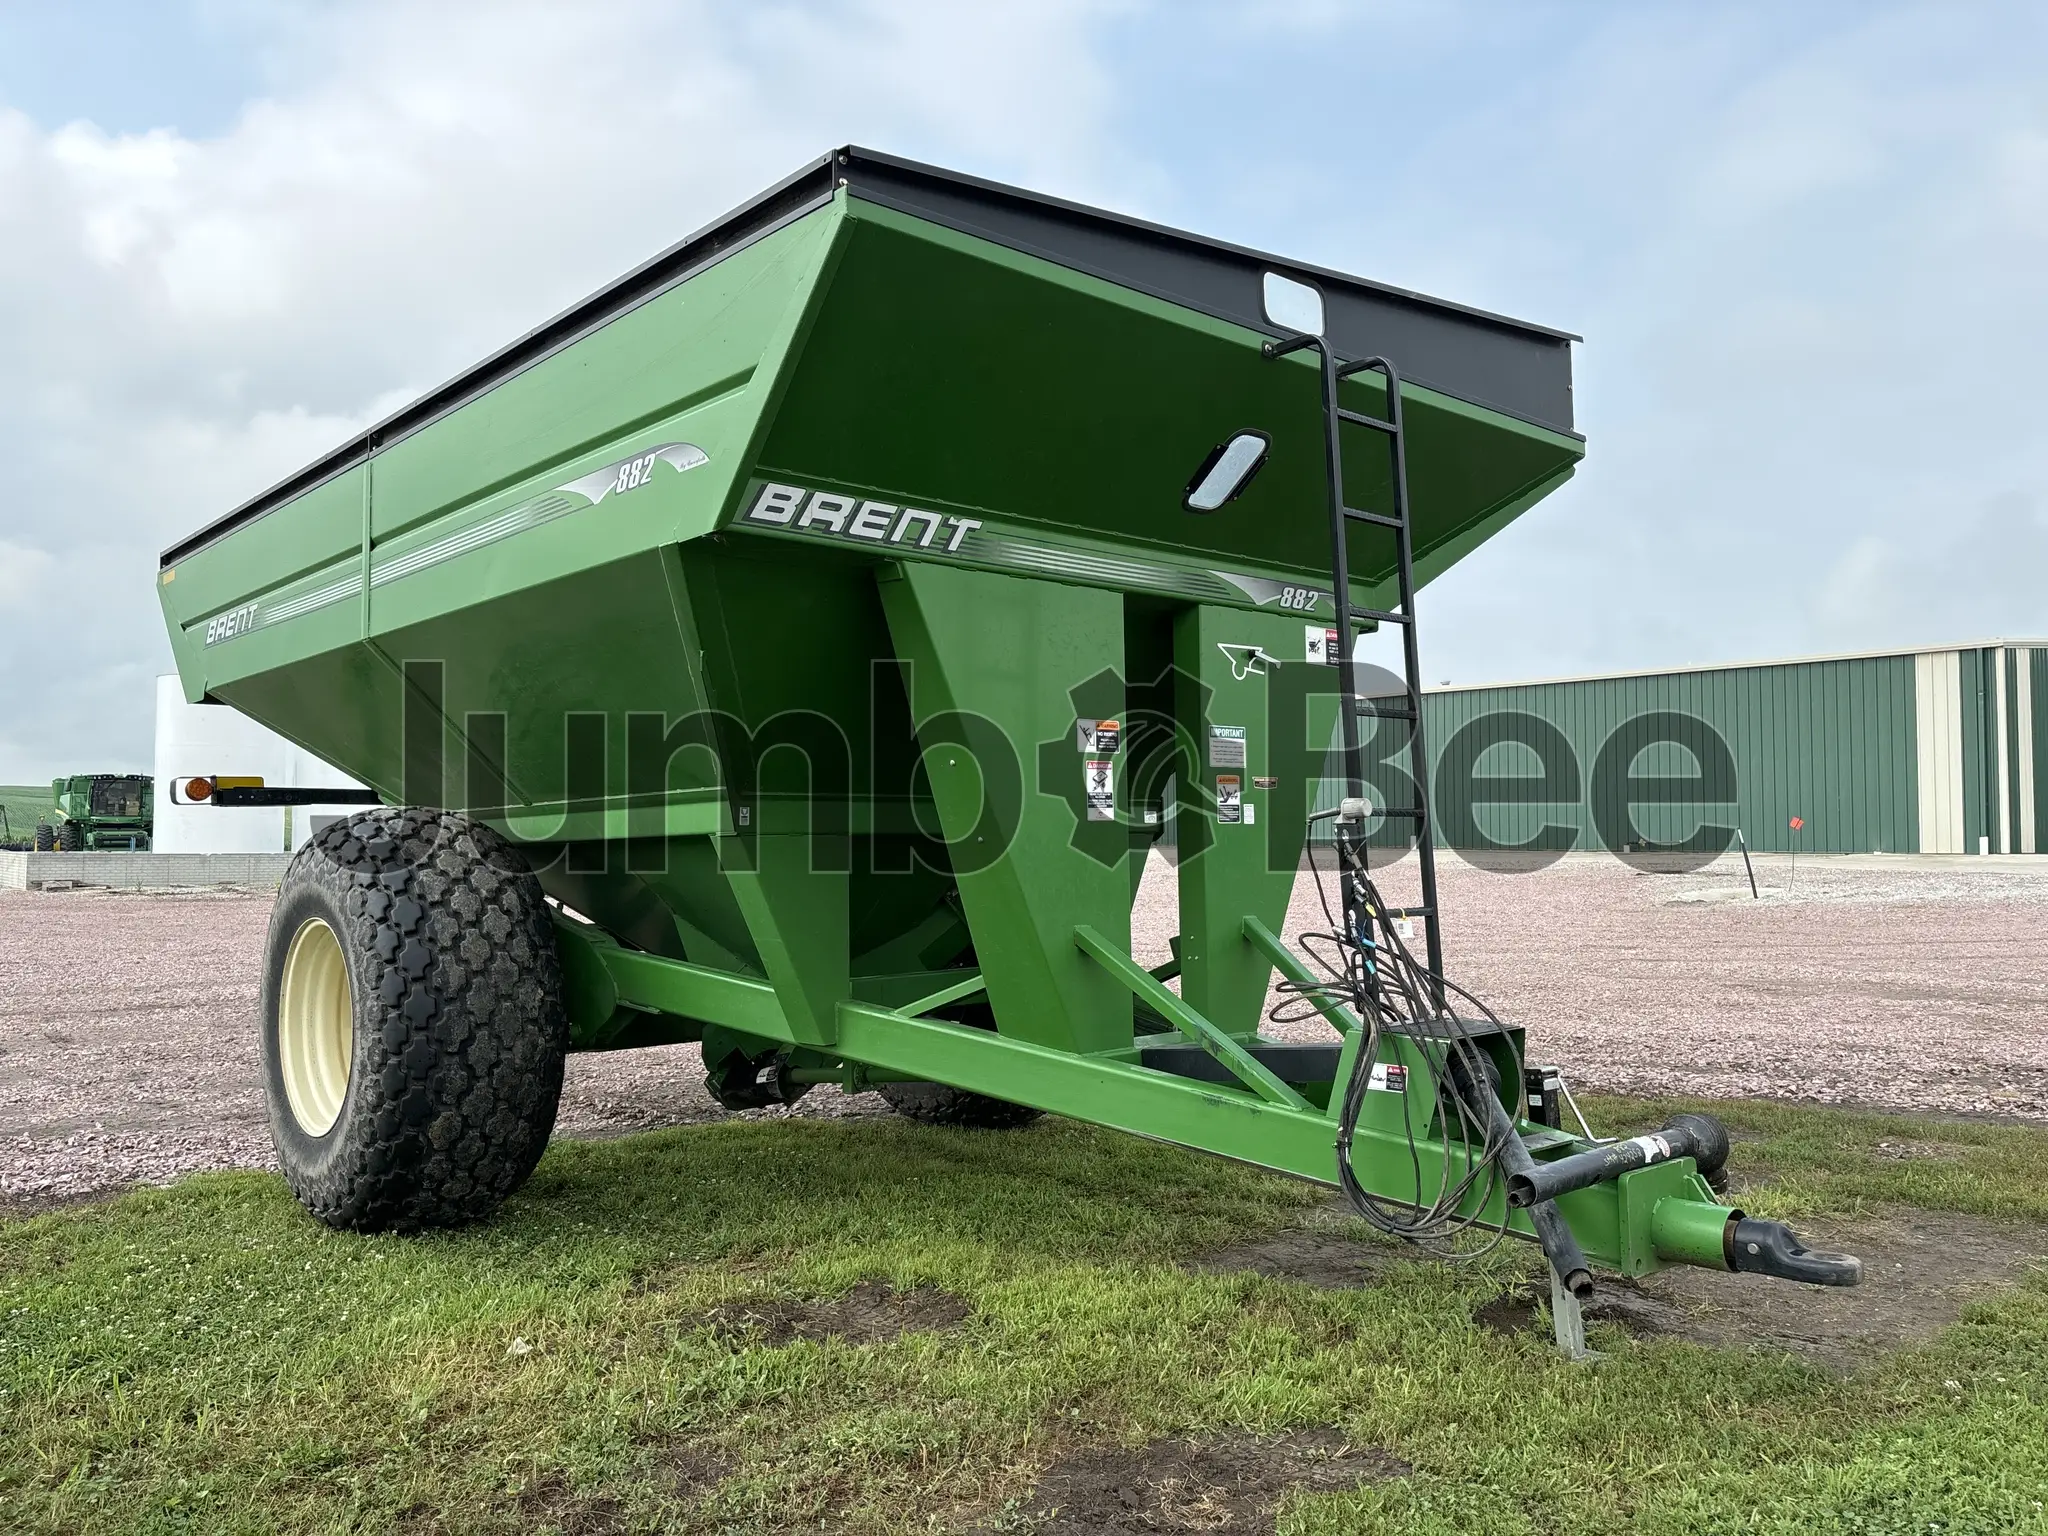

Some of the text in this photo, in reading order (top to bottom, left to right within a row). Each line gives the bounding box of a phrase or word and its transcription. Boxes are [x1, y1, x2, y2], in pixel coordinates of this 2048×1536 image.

[615, 453, 656, 495] 882
[750, 482, 983, 552] BRENT
[1280, 586, 1319, 611] 882
[206, 603, 258, 645] BRENT
[1210, 727, 1243, 738] IMPORTANT
